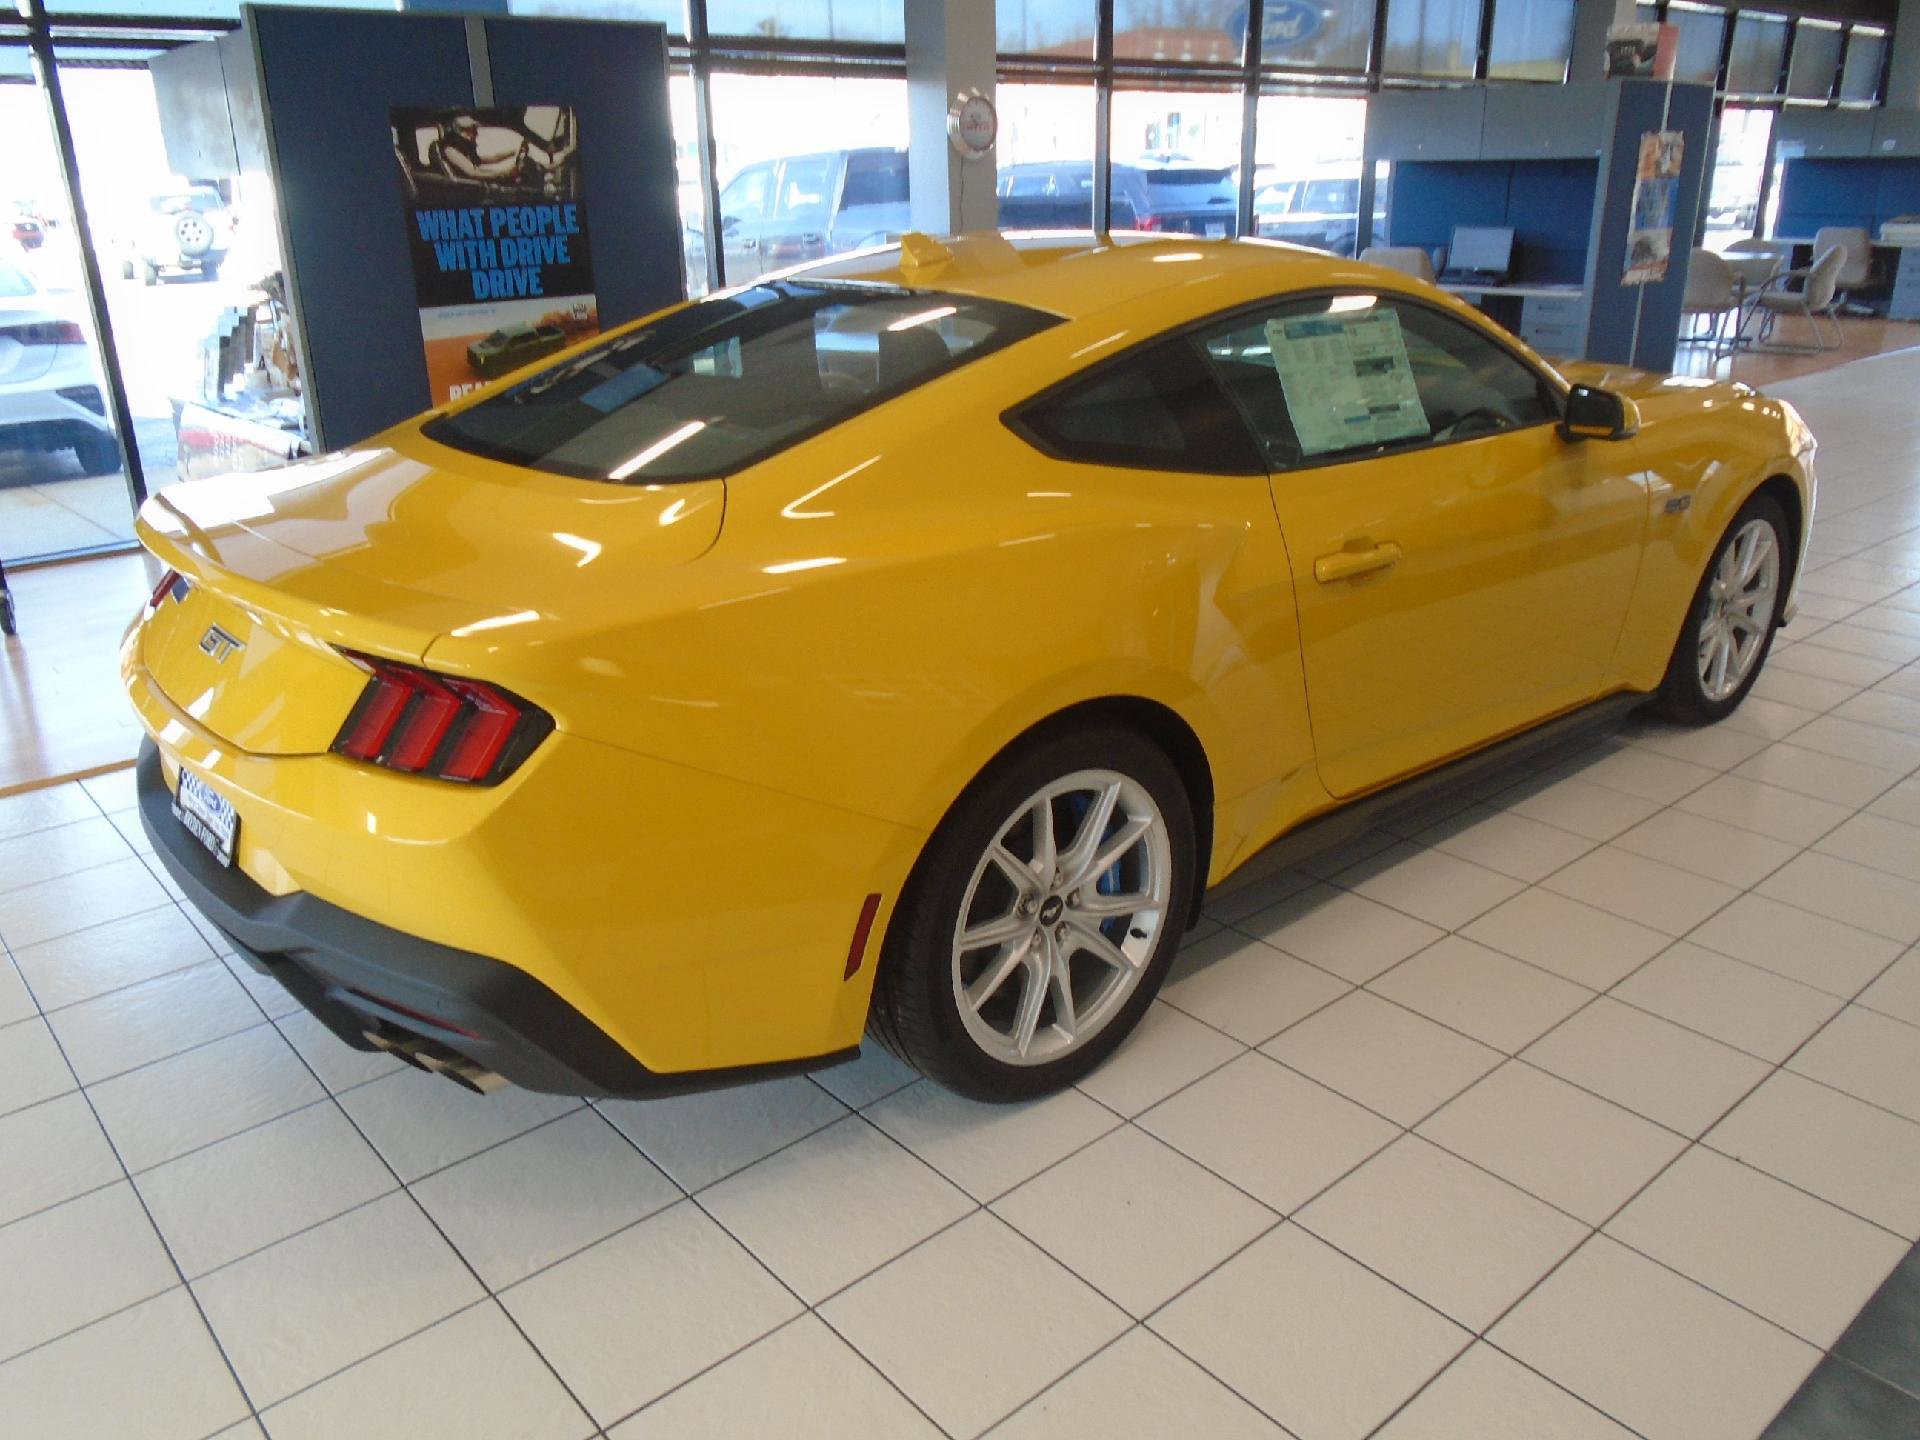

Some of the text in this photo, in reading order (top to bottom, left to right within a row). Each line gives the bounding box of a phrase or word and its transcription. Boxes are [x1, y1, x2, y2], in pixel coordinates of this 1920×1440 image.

[415, 203, 580, 241] WHAT PEOPLE
[433, 235, 571, 272] WITH DRIVE
[471, 266, 544, 299] DRIVE
[199, 622, 246, 664] GT
